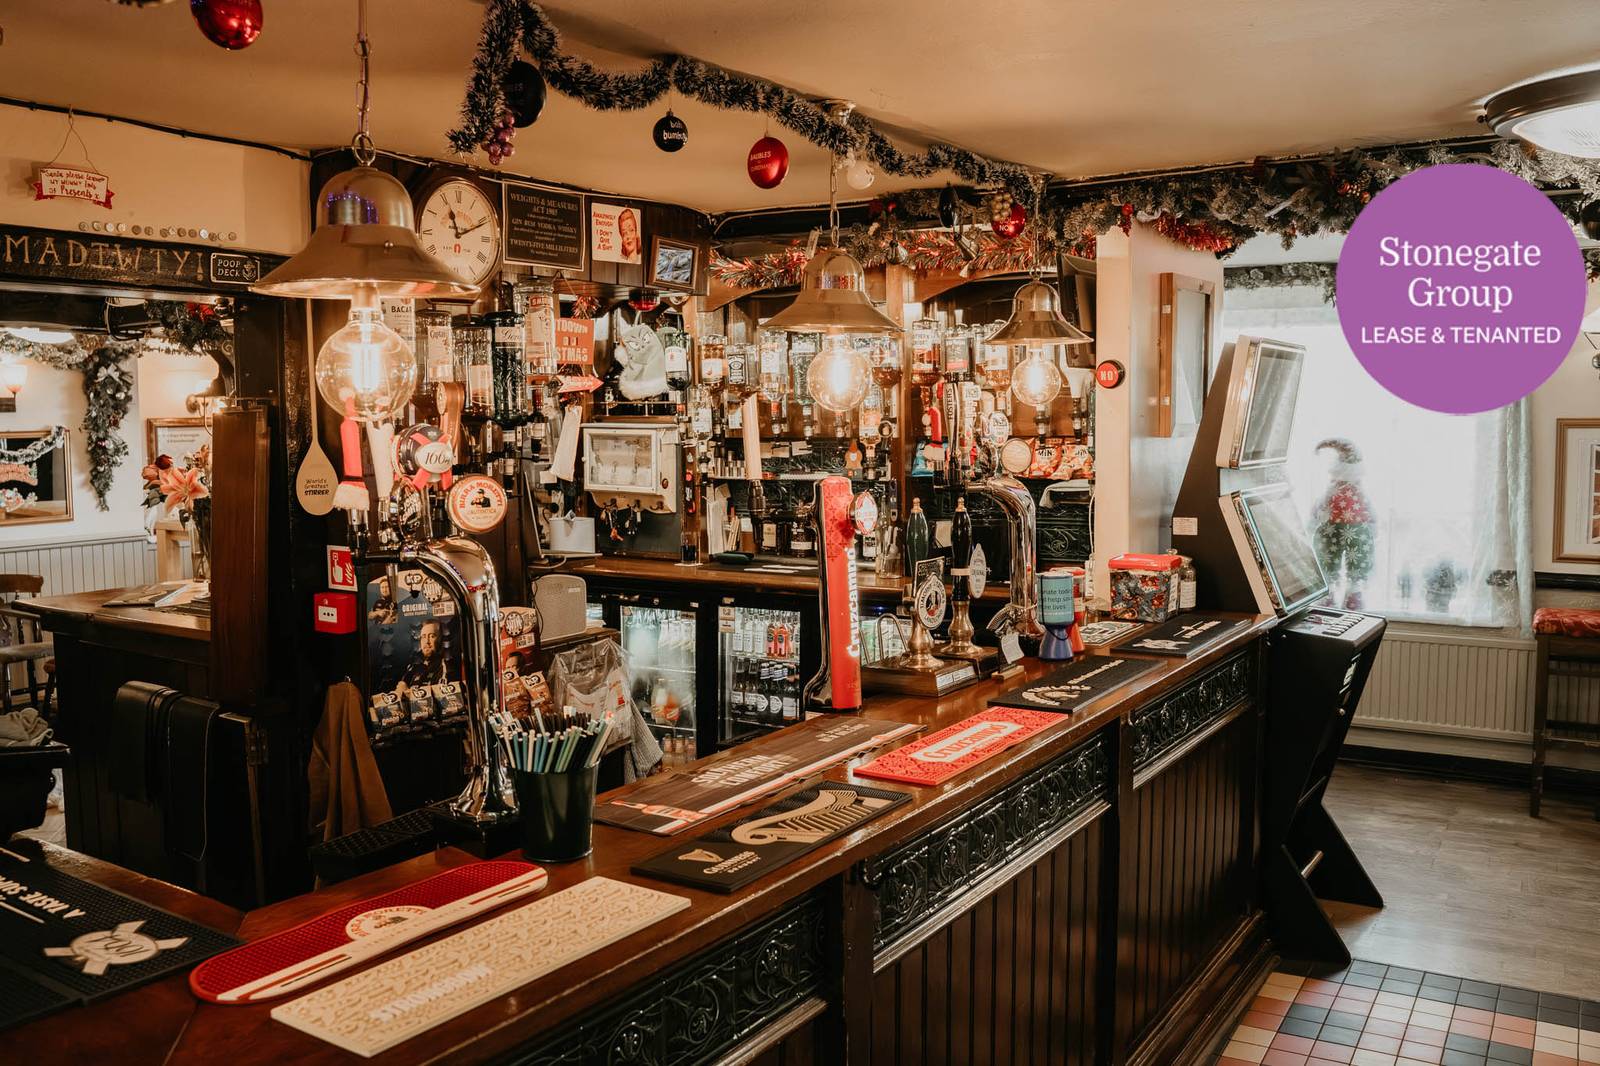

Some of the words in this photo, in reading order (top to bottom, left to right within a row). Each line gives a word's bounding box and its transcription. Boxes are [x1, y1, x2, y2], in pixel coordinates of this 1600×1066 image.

[217, 259, 241, 268] POOP
[217, 268, 241, 277] DECK
[402, 603, 429, 613] ORIGINAL
[691, 754, 771, 784] SOUTHERN
[718, 759, 790, 787] COMFORT
[19, 891, 70, 914] TASTE
